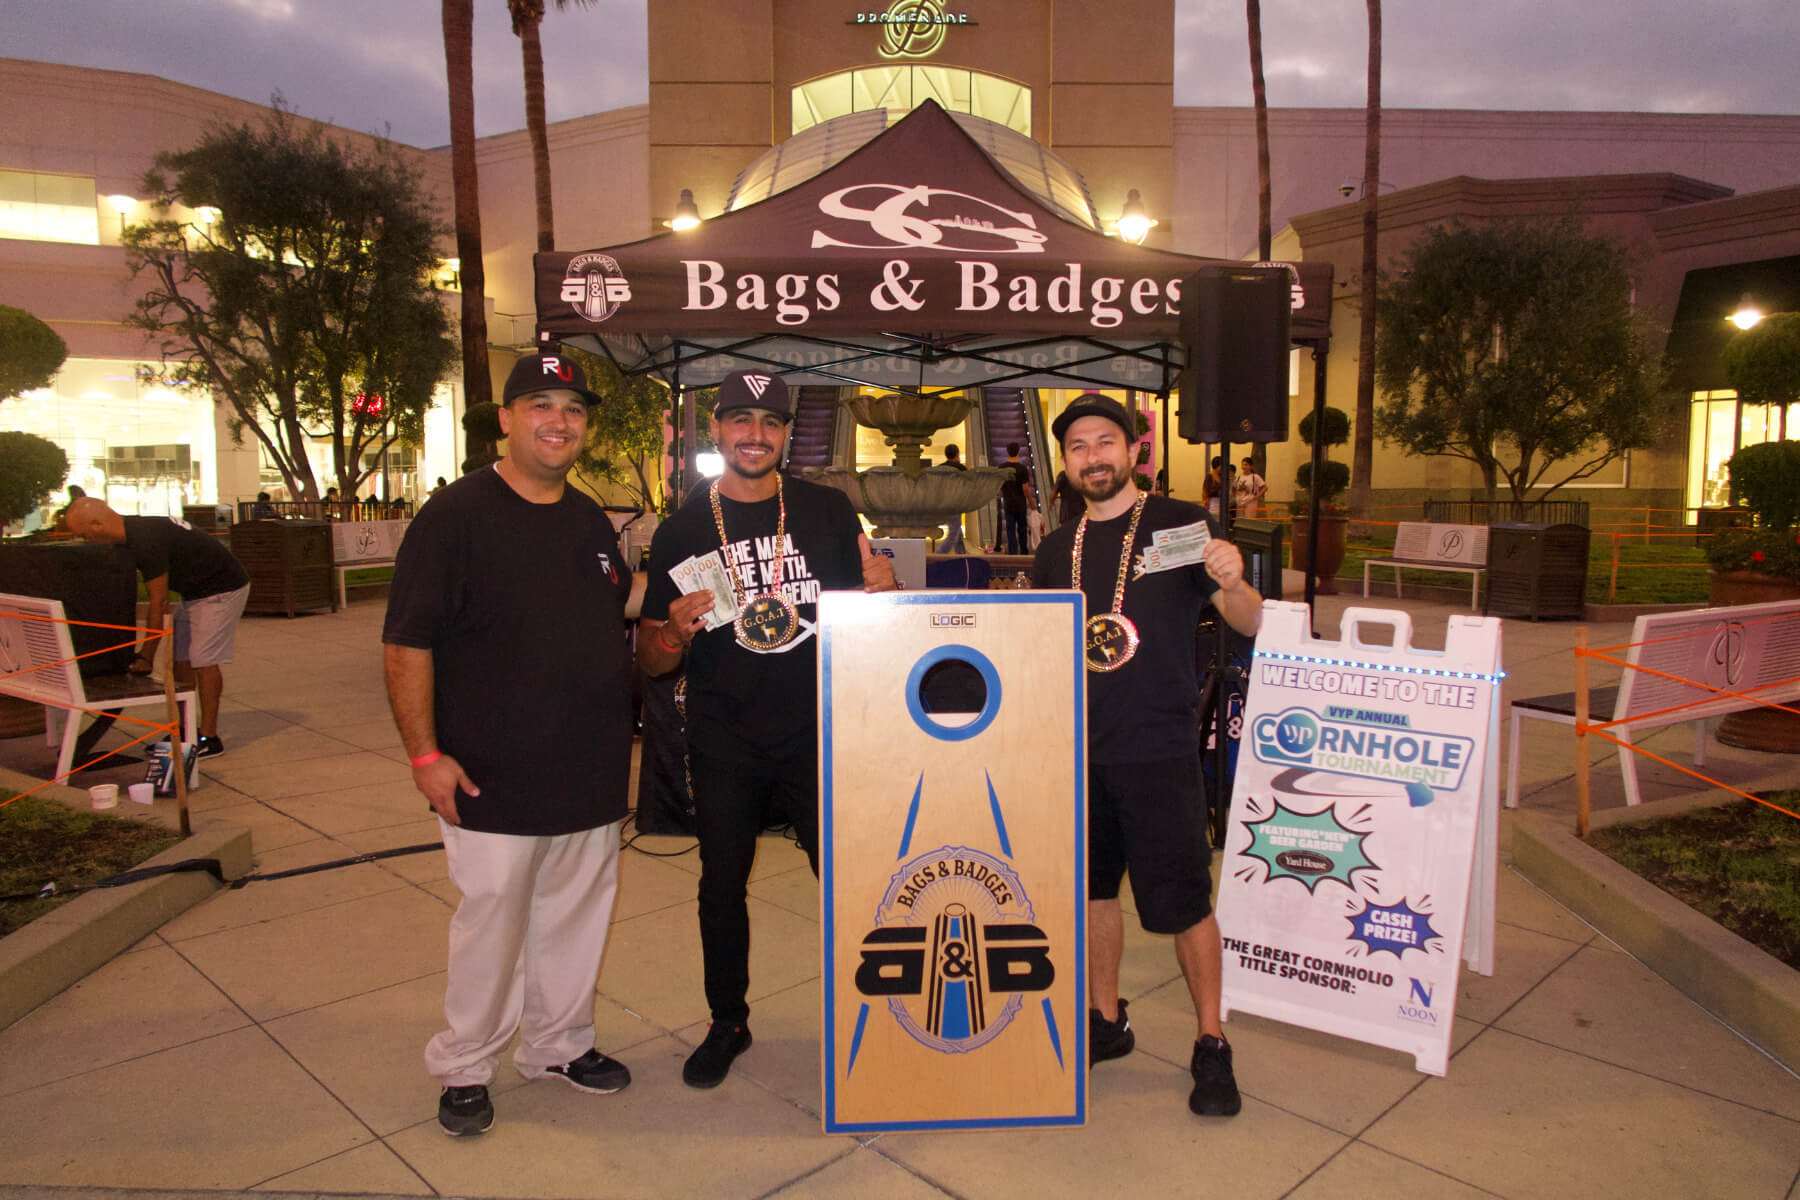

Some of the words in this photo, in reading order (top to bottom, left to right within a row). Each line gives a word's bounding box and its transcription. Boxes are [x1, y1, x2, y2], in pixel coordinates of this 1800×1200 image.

[856, 12, 968, 24] PROMENADE
[680, 260, 840, 326] Bags
[870, 259, 926, 312] &
[954, 261, 1183, 328] Badges
[720, 540, 754, 566] THE
[760, 556, 812, 585] MTH.
[932, 615, 974, 626] LOGIC
[1262, 664, 1379, 697] WELCOME
[1383, 677, 1418, 702] TO
[1423, 681, 1476, 709] THE
[1329, 706, 1353, 719] VYP
[1355, 710, 1408, 726] ANNUAL
[1316, 751, 1450, 784] TOURNAMENT
[897, 866, 936, 908] BAGS
[938, 861, 950, 877] &
[954, 859, 1013, 906] BADGES
[1370, 910, 1413, 929] CASH
[1363, 923, 1417, 945] PRIZE!
[1223, 937, 1250, 954] THE
[1252, 945, 1300, 966] GREAT
[1303, 956, 1394, 987] CORNHOLIO
[1239, 955, 1276, 975] TITLE
[1279, 966, 1356, 994] SPONSOR:
[1399, 1004, 1438, 1022] NOON
